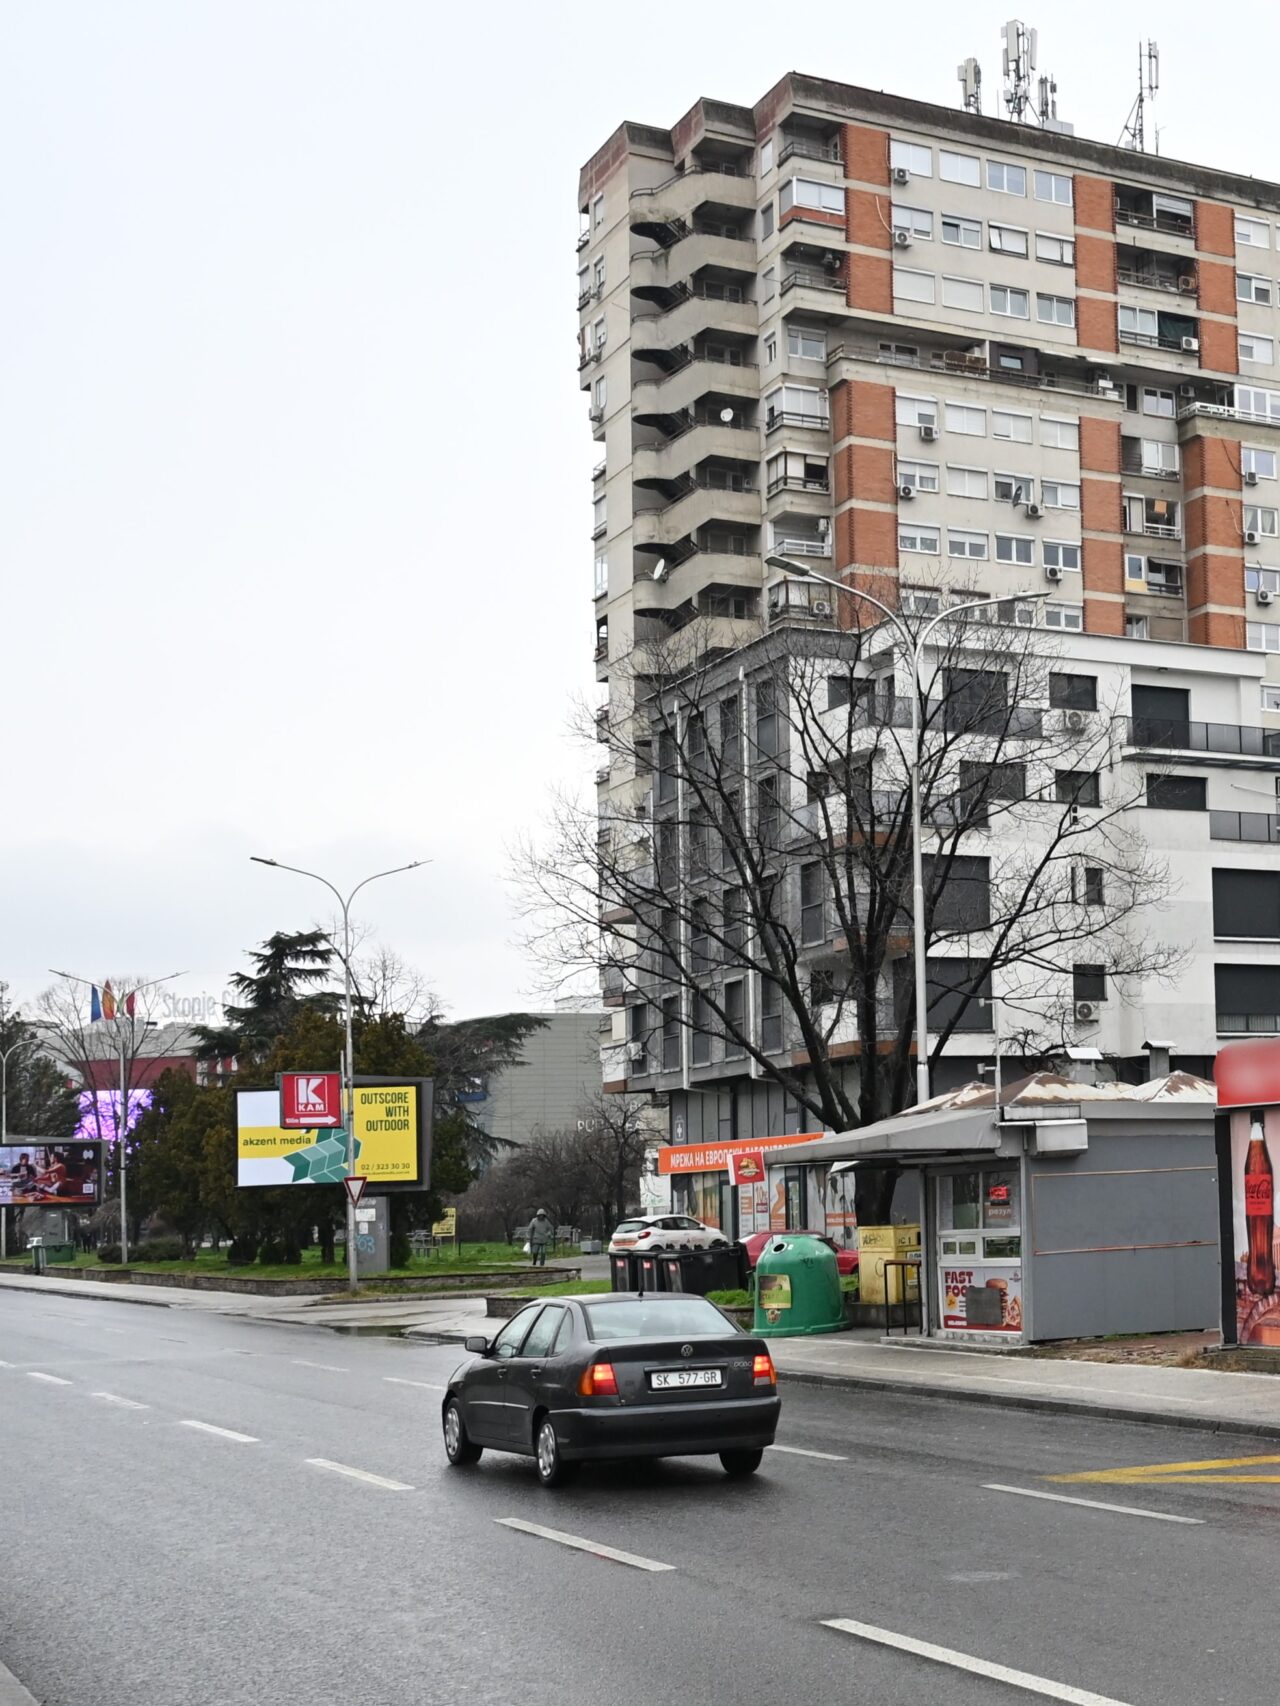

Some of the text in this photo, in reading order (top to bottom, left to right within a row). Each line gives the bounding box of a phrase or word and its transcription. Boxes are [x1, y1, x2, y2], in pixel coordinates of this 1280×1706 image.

[162, 991, 215, 1022] Skopje
[360, 1091, 409, 1104] OUTSCORE
[385, 1106, 410, 1118] WITH
[366, 1119, 410, 1132] OUTDOOR
[243, 1135, 311, 1146] akzent media
[670, 1153, 694, 1168] МРЕЖА
[695, 1151, 704, 1166] НА
[360, 1163, 369, 1171] 02
[944, 1271, 973, 1284] FAST
[945, 1285, 976, 1297] FOO
[656, 1371, 717, 1386] SK 577-GR
